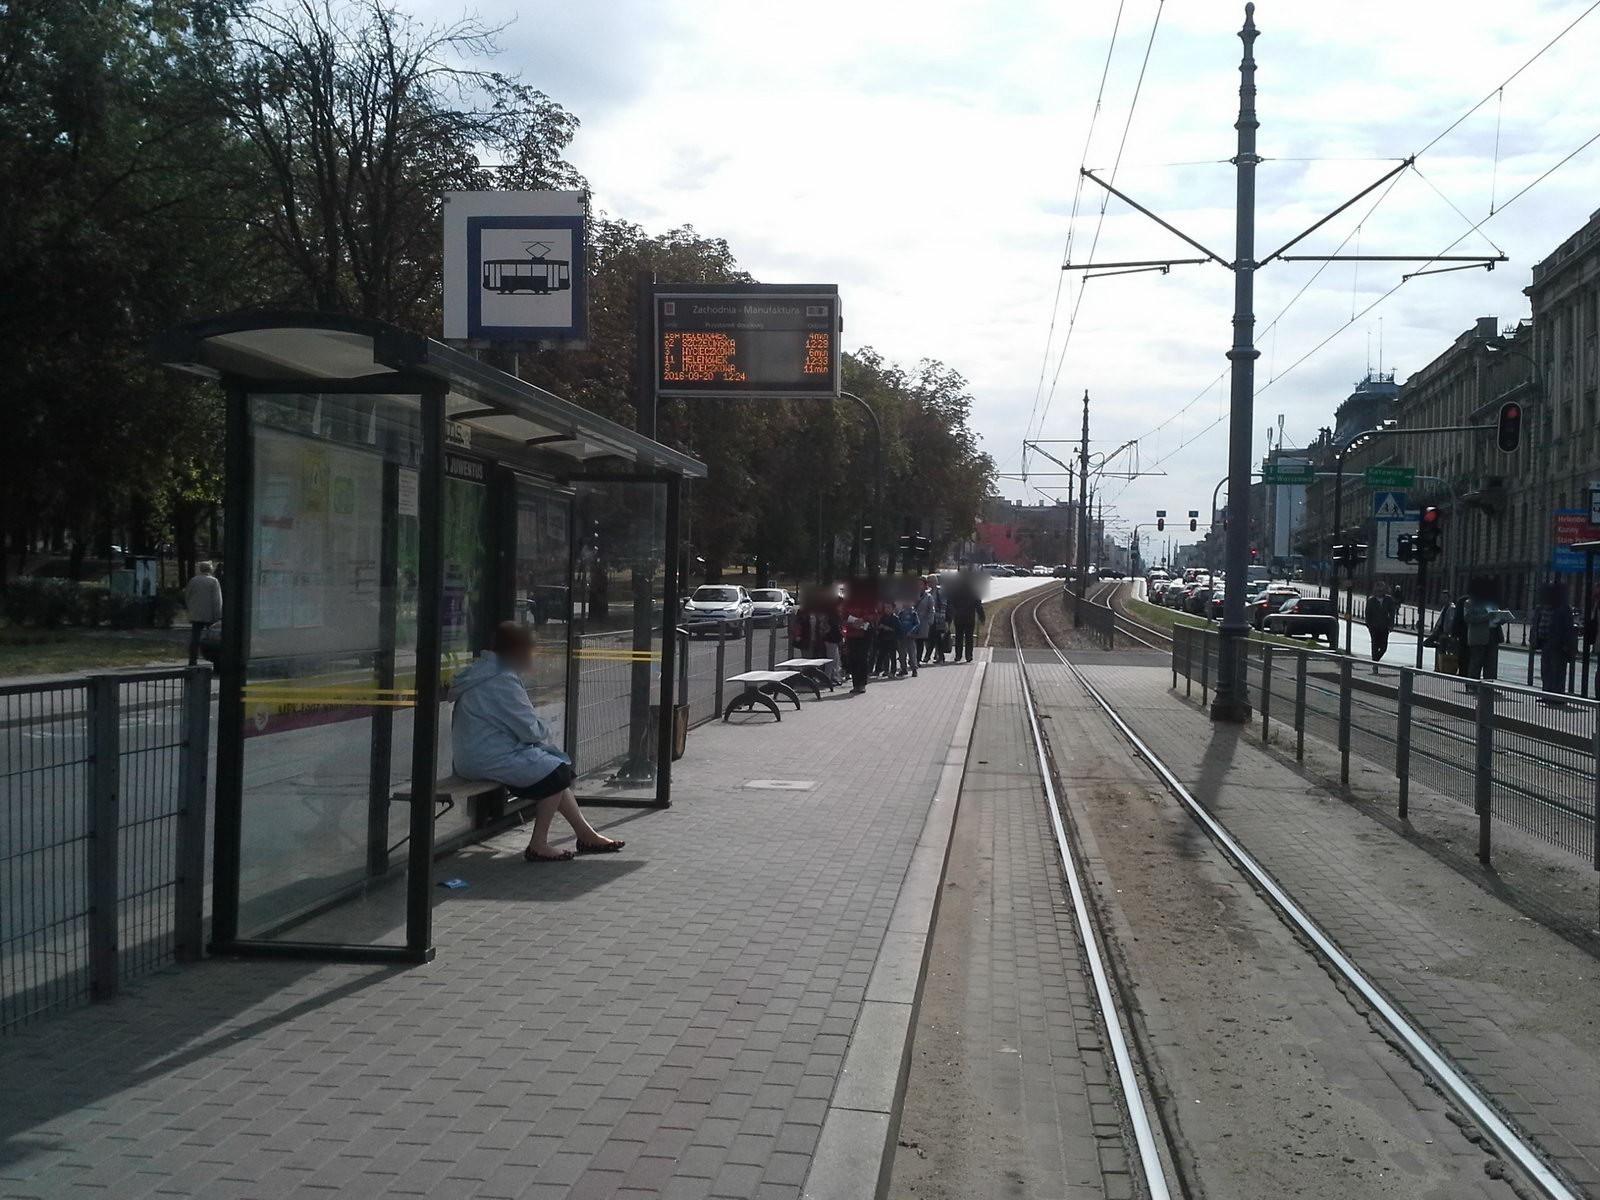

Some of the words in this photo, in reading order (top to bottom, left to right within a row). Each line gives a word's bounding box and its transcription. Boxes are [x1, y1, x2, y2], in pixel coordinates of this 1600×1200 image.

[692, 305, 737, 315] Zachodnia
[744, 305, 800, 315] Manufaktura
[664, 355, 675, 364] 11
[663, 372, 714, 381] 2016-09-20
[722, 372, 747, 381] 12:24
